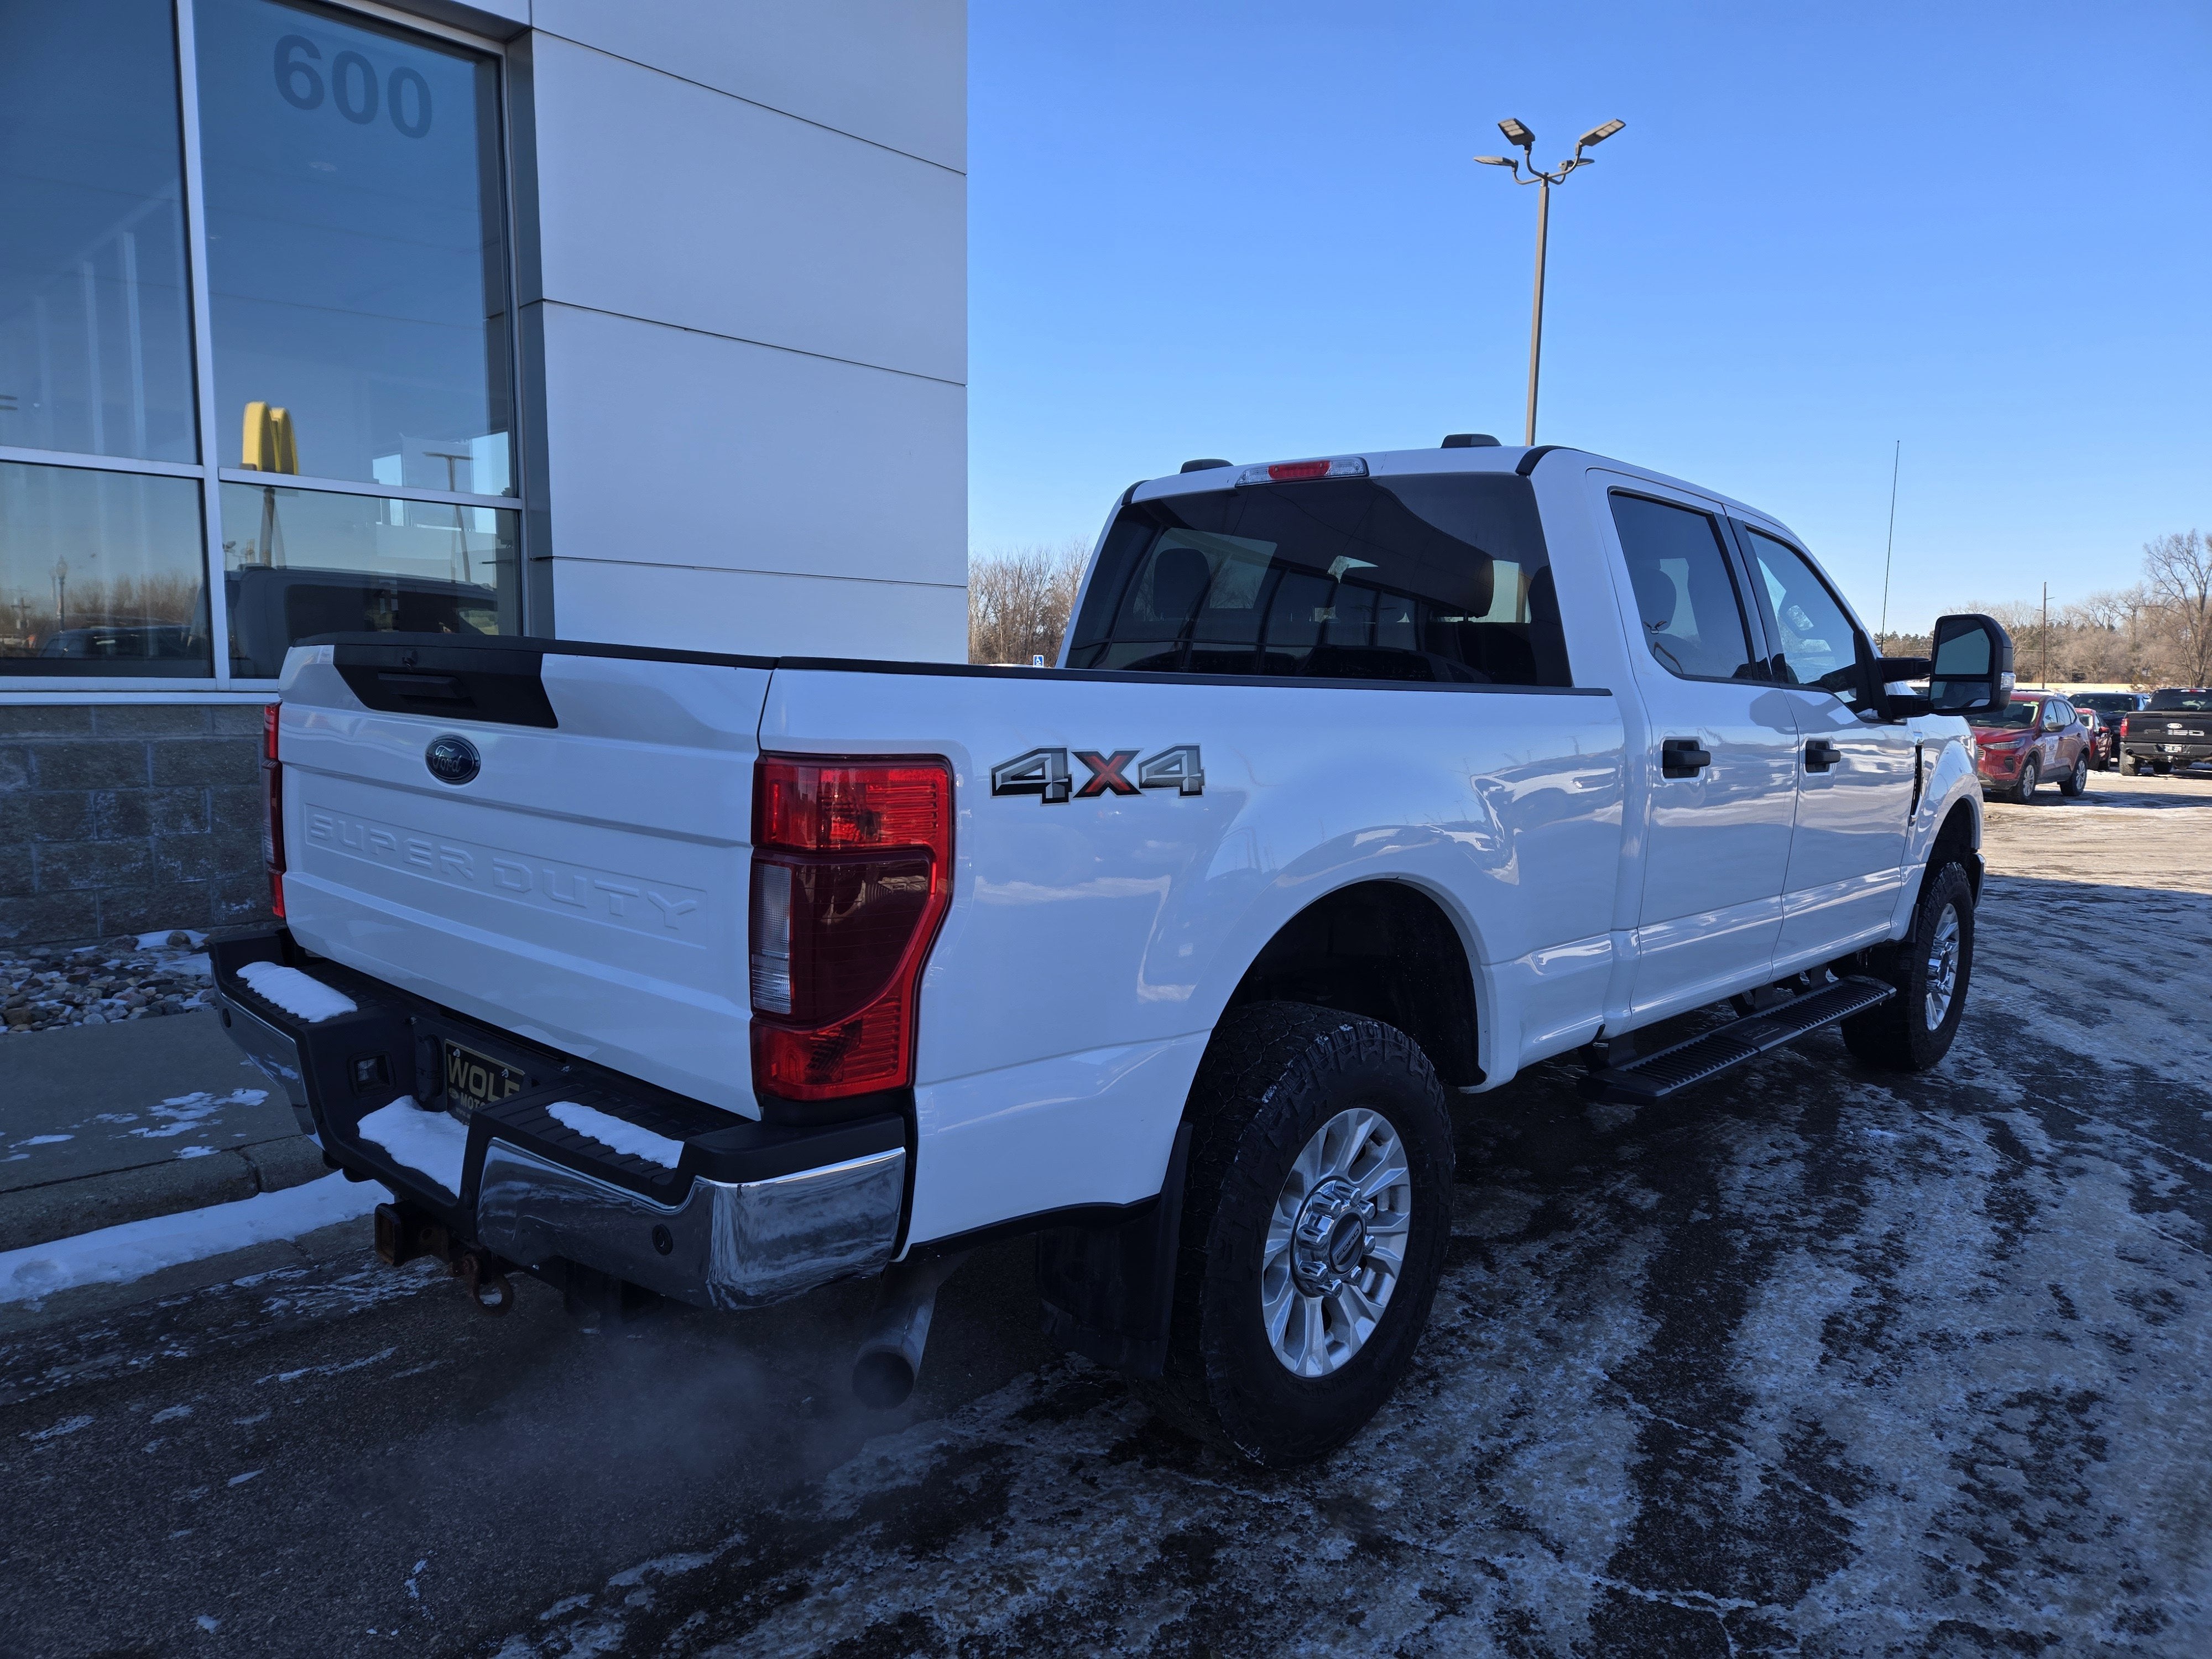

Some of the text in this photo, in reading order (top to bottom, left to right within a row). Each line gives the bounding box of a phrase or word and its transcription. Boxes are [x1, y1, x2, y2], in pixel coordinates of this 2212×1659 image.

[274, 34, 432, 139] 600
[432, 745, 463, 773] Ford
[310, 813, 697, 931] SUPER DUTY
[1337, 1228, 1359, 1260] FORD
